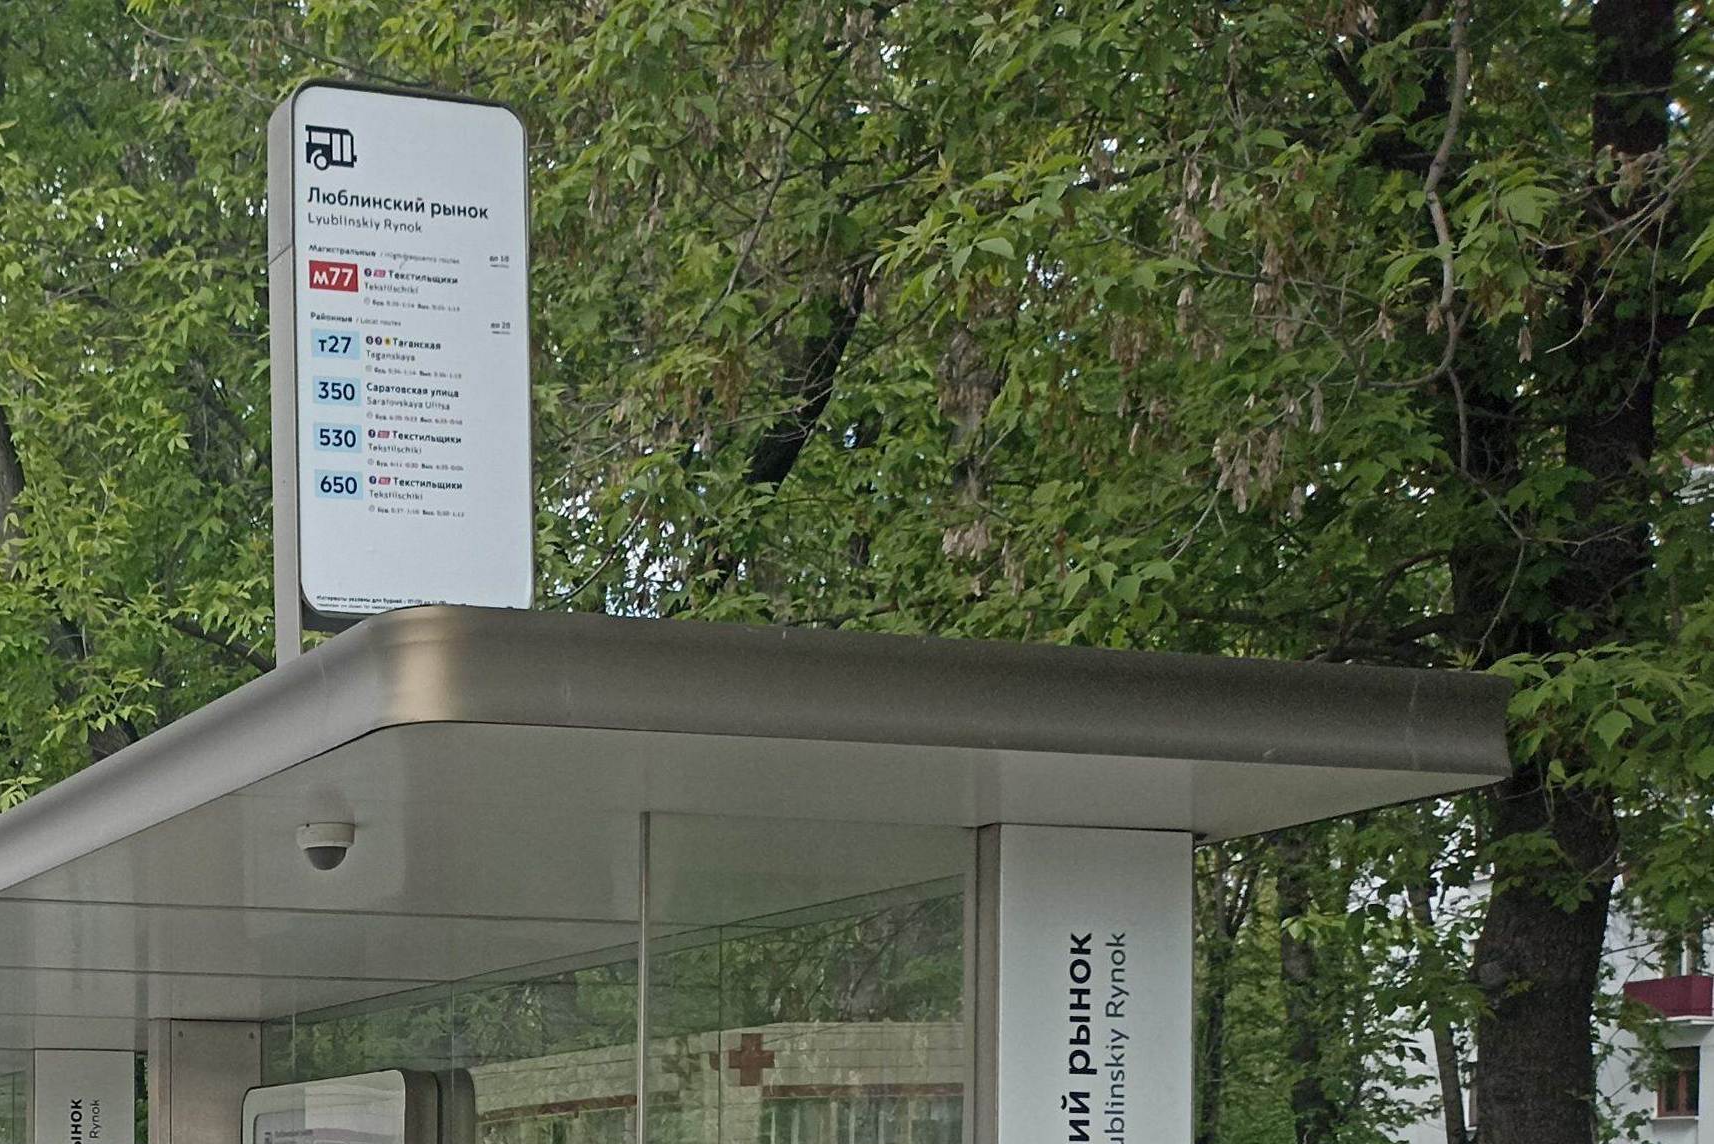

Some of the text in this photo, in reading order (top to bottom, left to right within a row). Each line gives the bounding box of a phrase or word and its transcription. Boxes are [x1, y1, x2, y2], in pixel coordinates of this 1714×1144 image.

[308, 187, 489, 220] Люблинский рынок
[308, 213, 422, 234] Lyublinskiy Rynok
[388, 269, 459, 285] Текстильщики
[392, 337, 442, 350] Таганская
[317, 381, 356, 401] 350
[366, 382, 460, 398] Саратовская улица
[319, 428, 357, 448] 530
[392, 430, 463, 444] Текстильщики
[320, 475, 358, 496] 650
[393, 476, 463, 490] Текстильщики
[1104, 932, 1130, 1018] Rynok
[1068, 932, 1098, 1075] рынок
[89, 1098, 102, 1139] Rynok
